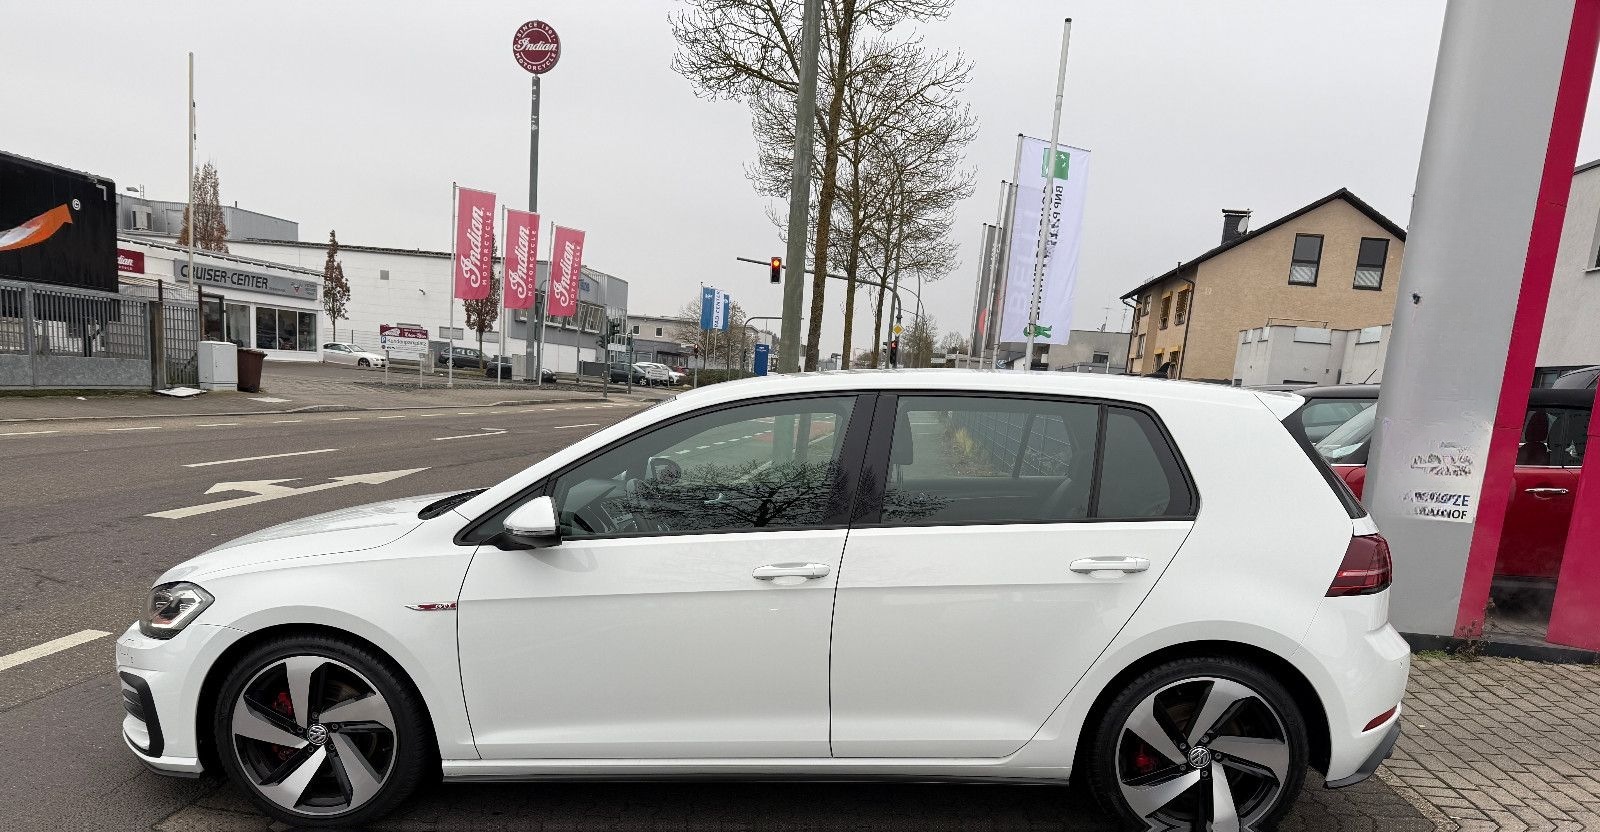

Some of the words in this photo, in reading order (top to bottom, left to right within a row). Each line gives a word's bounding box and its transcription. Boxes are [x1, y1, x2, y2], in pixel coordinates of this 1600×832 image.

[513, 37, 557, 52] Indian
[515, 52, 557, 71] MOTORCYCLE
[517, 22, 538, 38] SINCE
[117, 254, 134, 266] dian
[460, 205, 484, 288] Indian
[482, 212, 492, 286] MOTORCYCLE
[508, 225, 531, 299] Indian
[528, 230, 537, 297] MOTORCYCLE
[553, 240, 576, 307] Indian
[570, 246, 580, 306] MOTORCYCLE
